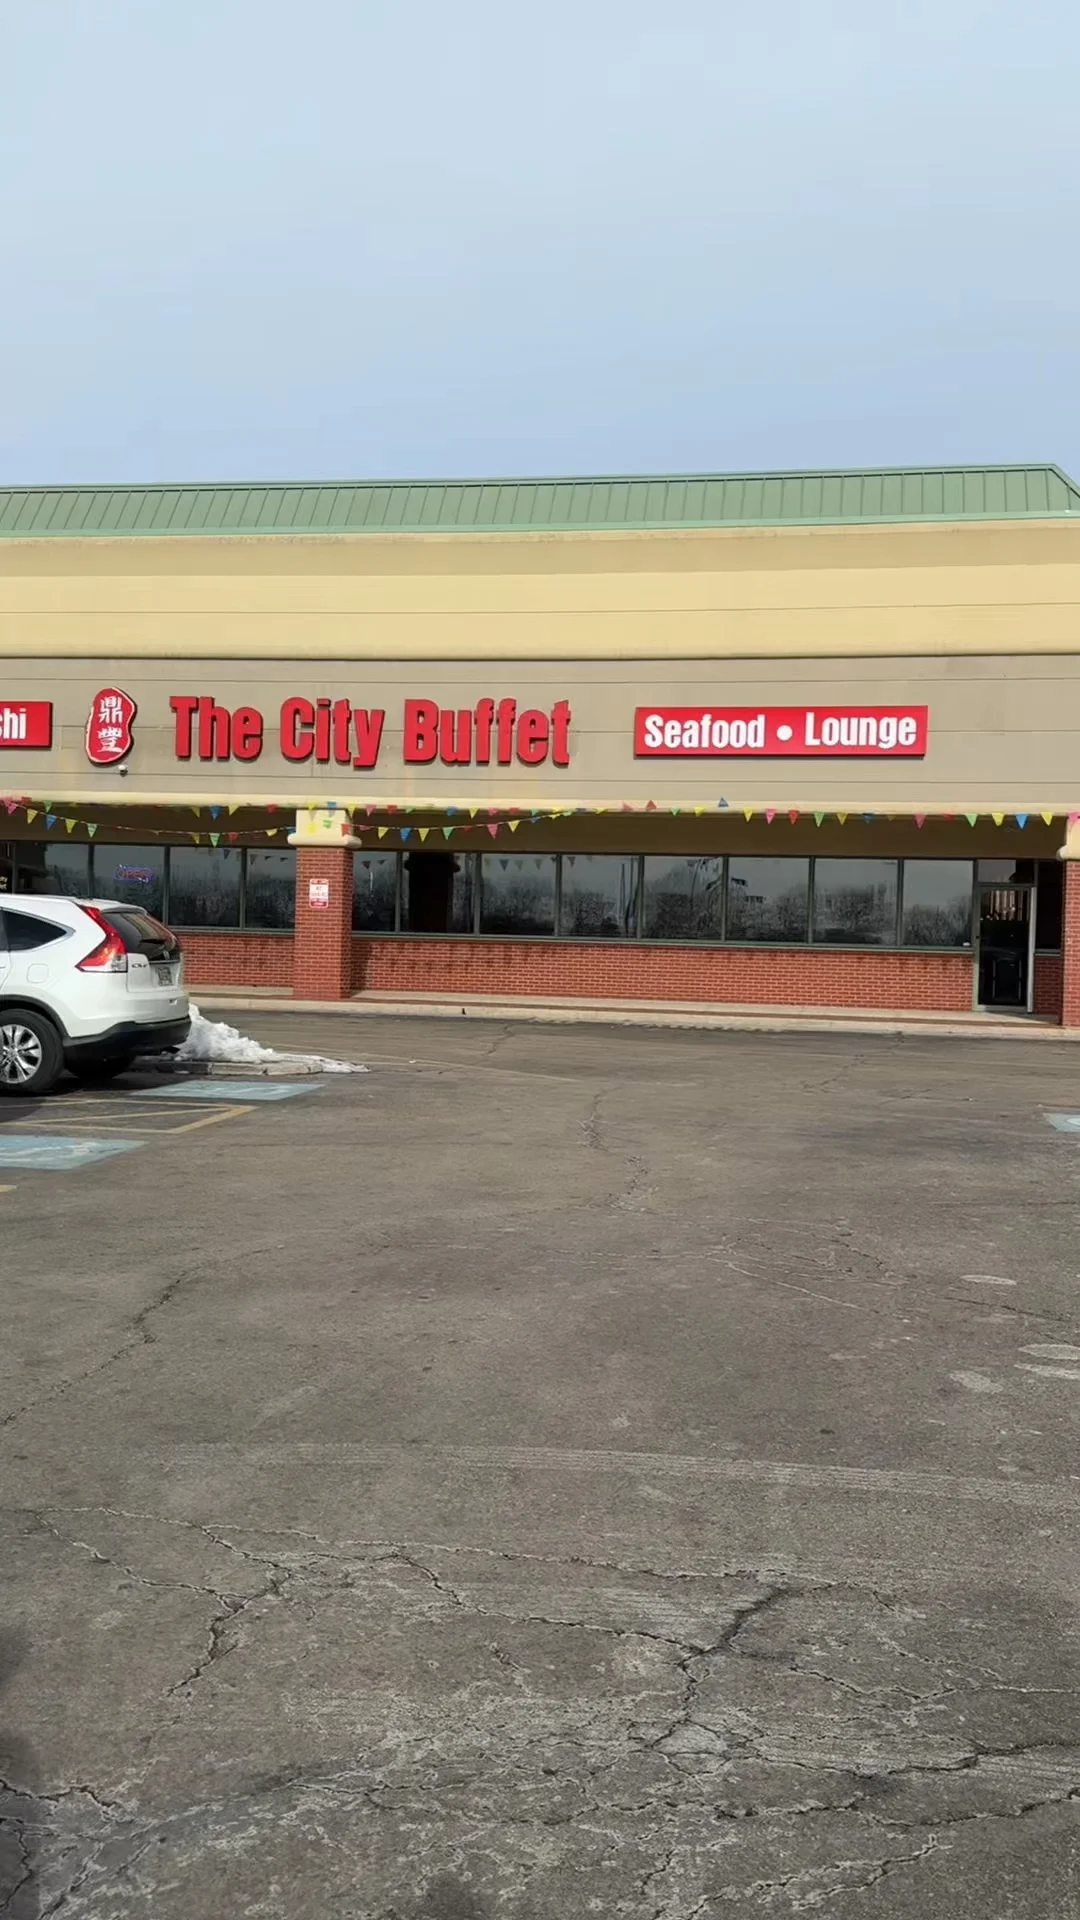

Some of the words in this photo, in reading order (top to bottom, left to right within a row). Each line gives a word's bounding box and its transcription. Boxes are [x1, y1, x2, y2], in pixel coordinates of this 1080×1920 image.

[0, 708, 26, 739] hi
[170, 696, 263, 760] The
[280, 697, 385, 767] City
[404, 698, 571, 765] Buffet
[645, 714, 766, 748] Seafood
[805, 712, 917, 749] Lounge
